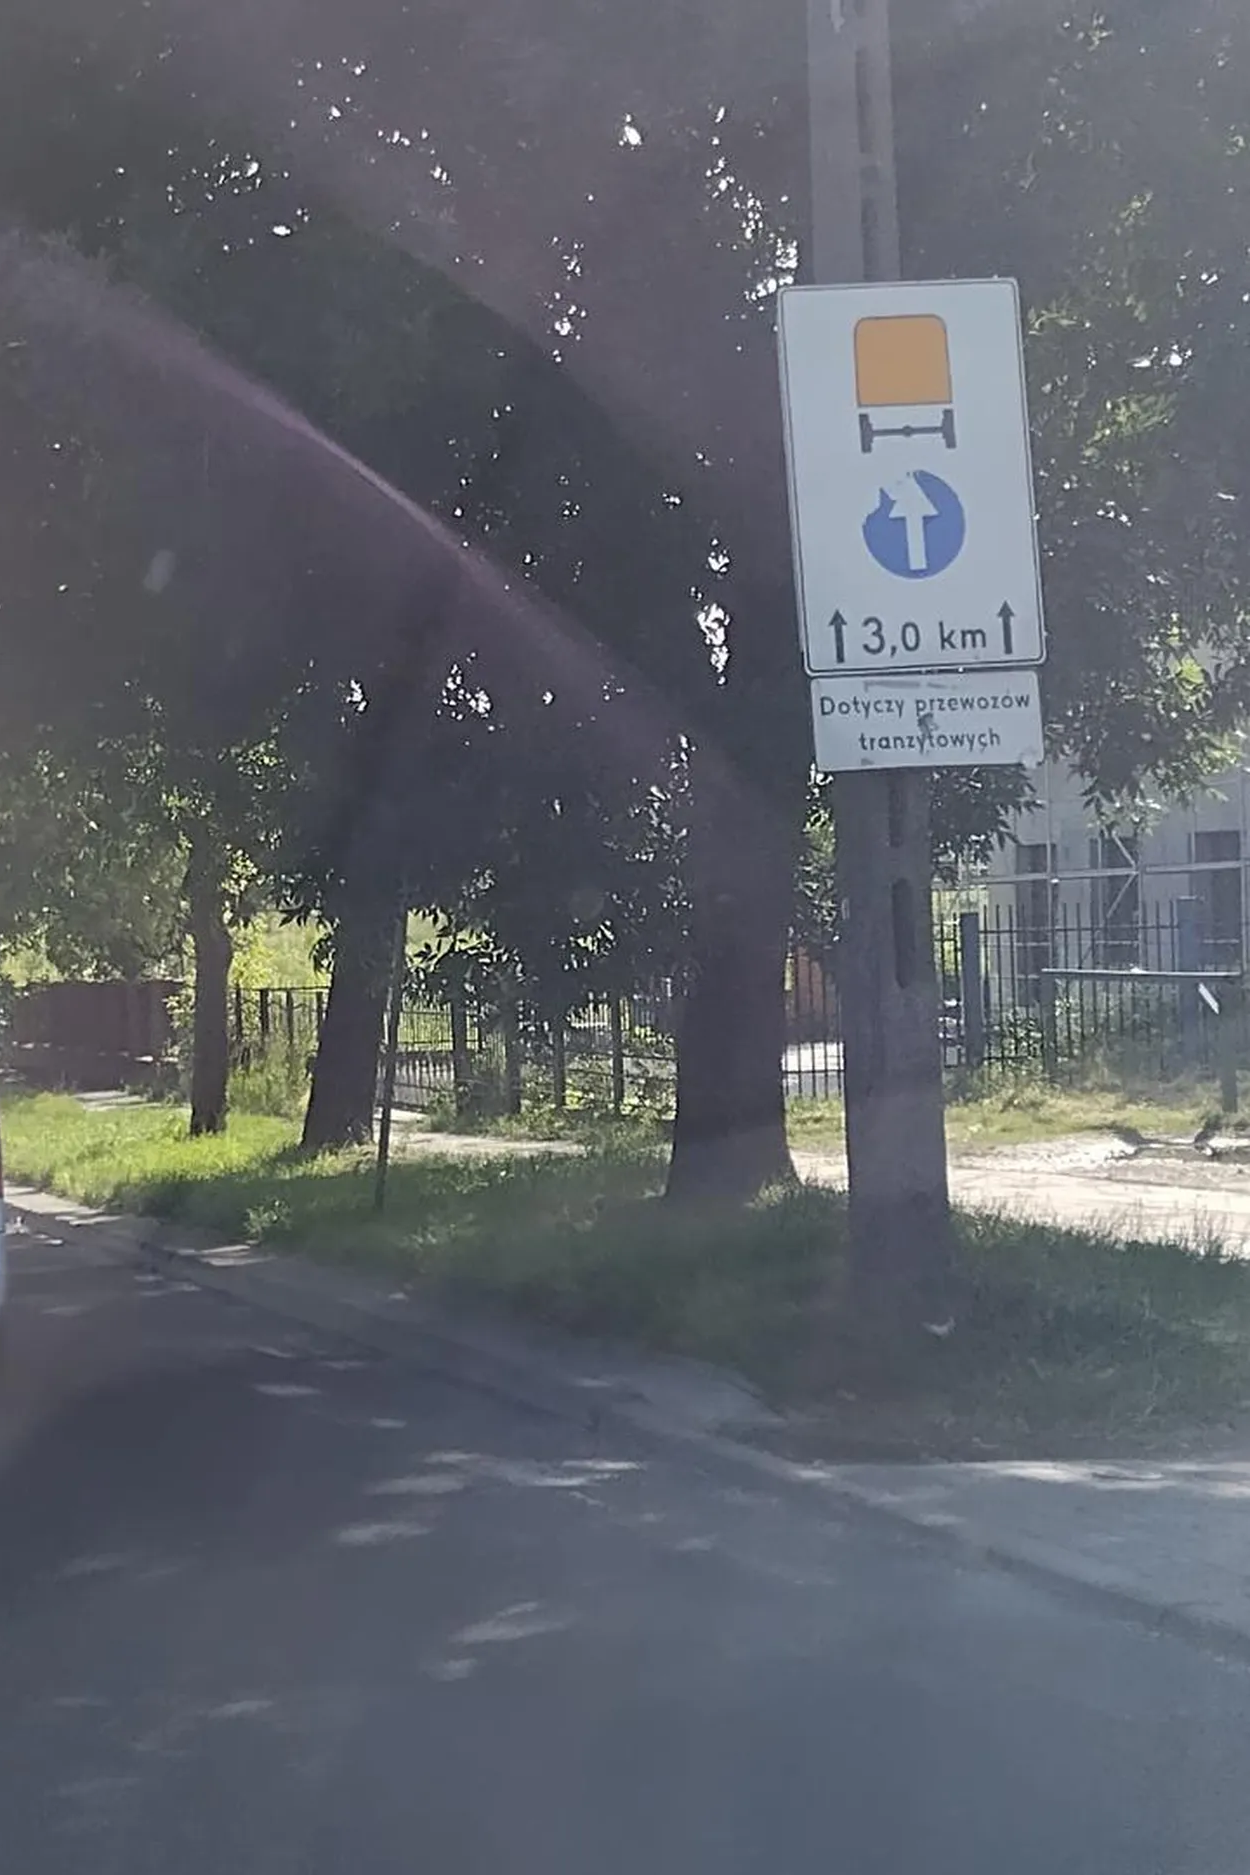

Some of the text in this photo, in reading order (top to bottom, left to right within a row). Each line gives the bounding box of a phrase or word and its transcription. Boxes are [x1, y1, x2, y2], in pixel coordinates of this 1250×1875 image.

[861, 616, 987, 658] 3,0 km
[819, 689, 1031, 719] Dotyczy przewozów
[858, 727, 1001, 754] tranzytowych
